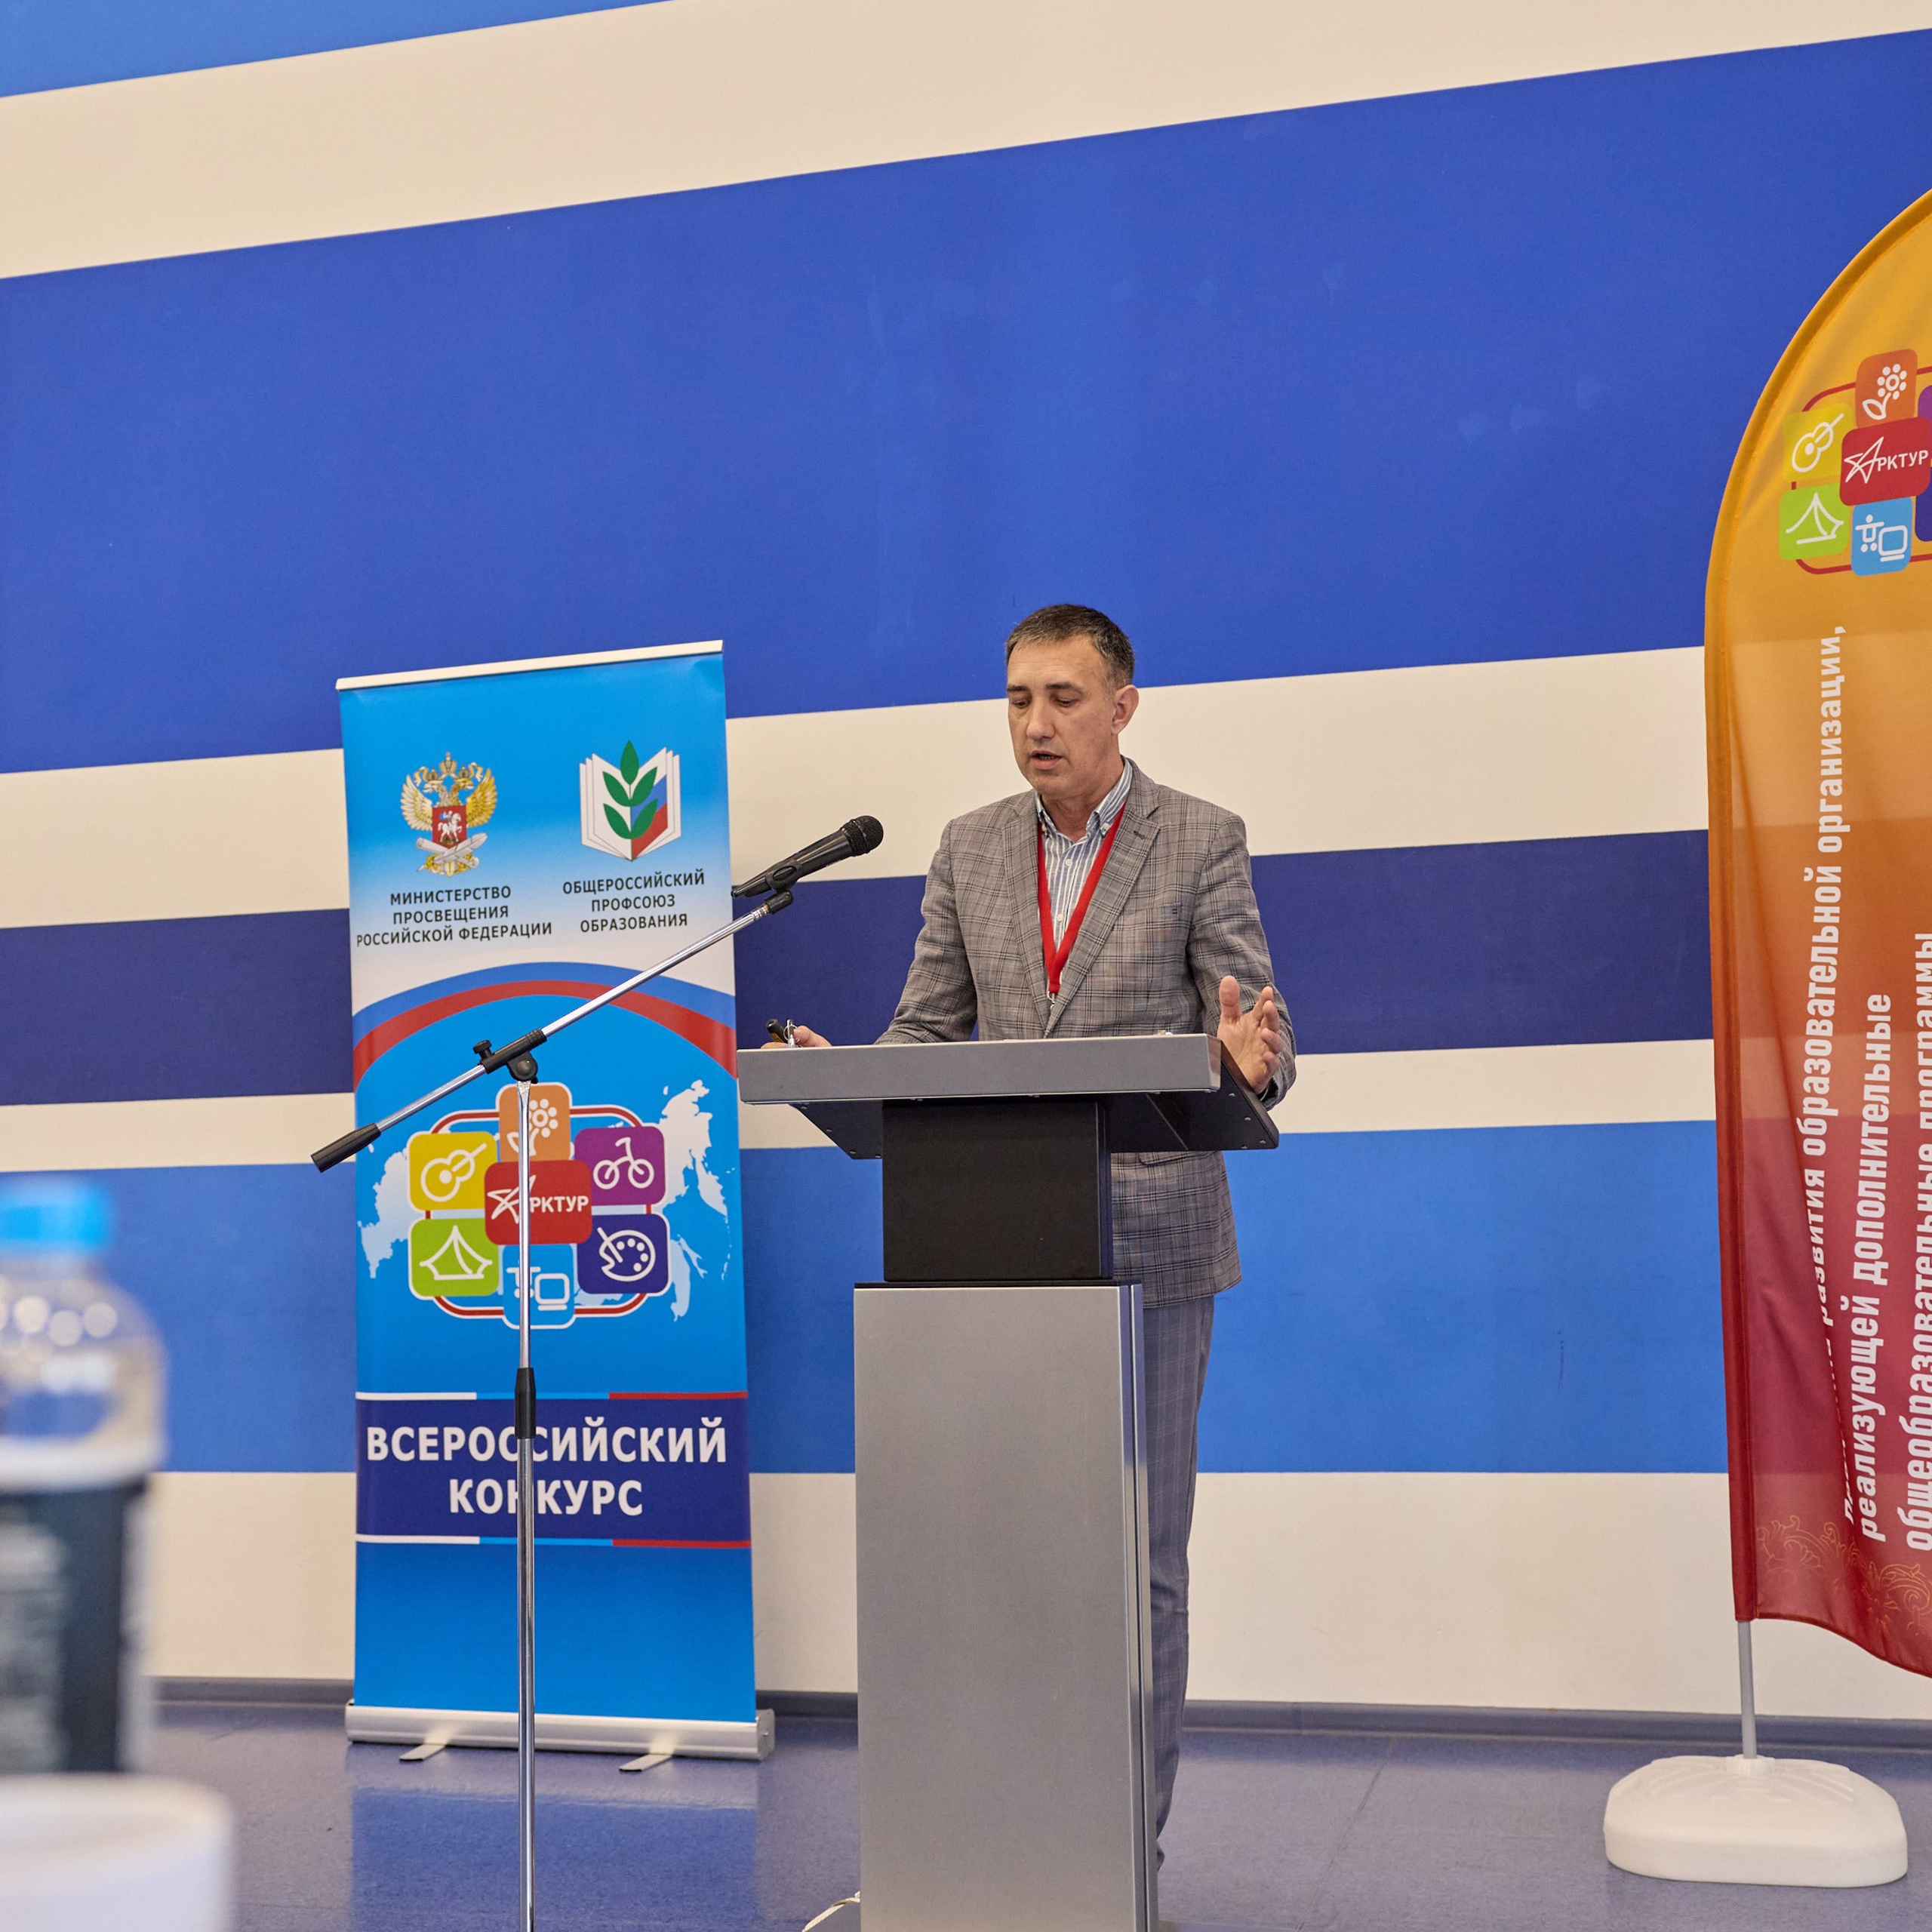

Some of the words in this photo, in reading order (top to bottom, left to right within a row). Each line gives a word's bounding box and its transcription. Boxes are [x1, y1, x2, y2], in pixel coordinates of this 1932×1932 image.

[1817, 626, 1850, 853] организации,
[390, 885, 512, 906] МИНИСТЕРСТВО
[562, 871, 706, 895] ОБЩЕРОССИЙСКИЙ
[392, 906, 509, 925] ПРОСВЕЩЕНИЯ
[591, 894, 676, 913] ПРОФСОЮЗ
[356, 927, 454, 948] РОССИЙСКОЙ
[458, 921, 553, 942] ФЕДЕРАЦИИ
[580, 913, 688, 934] ОБРАЗОВАНИЯ
[1795, 866, 1841, 1156] образовательной
[1853, 994, 1890, 1286] дополнительные
[1840, 1295, 1886, 1543] реализующей
[366, 1416, 727, 1463] ВСЕРОССИЙСКИЙ
